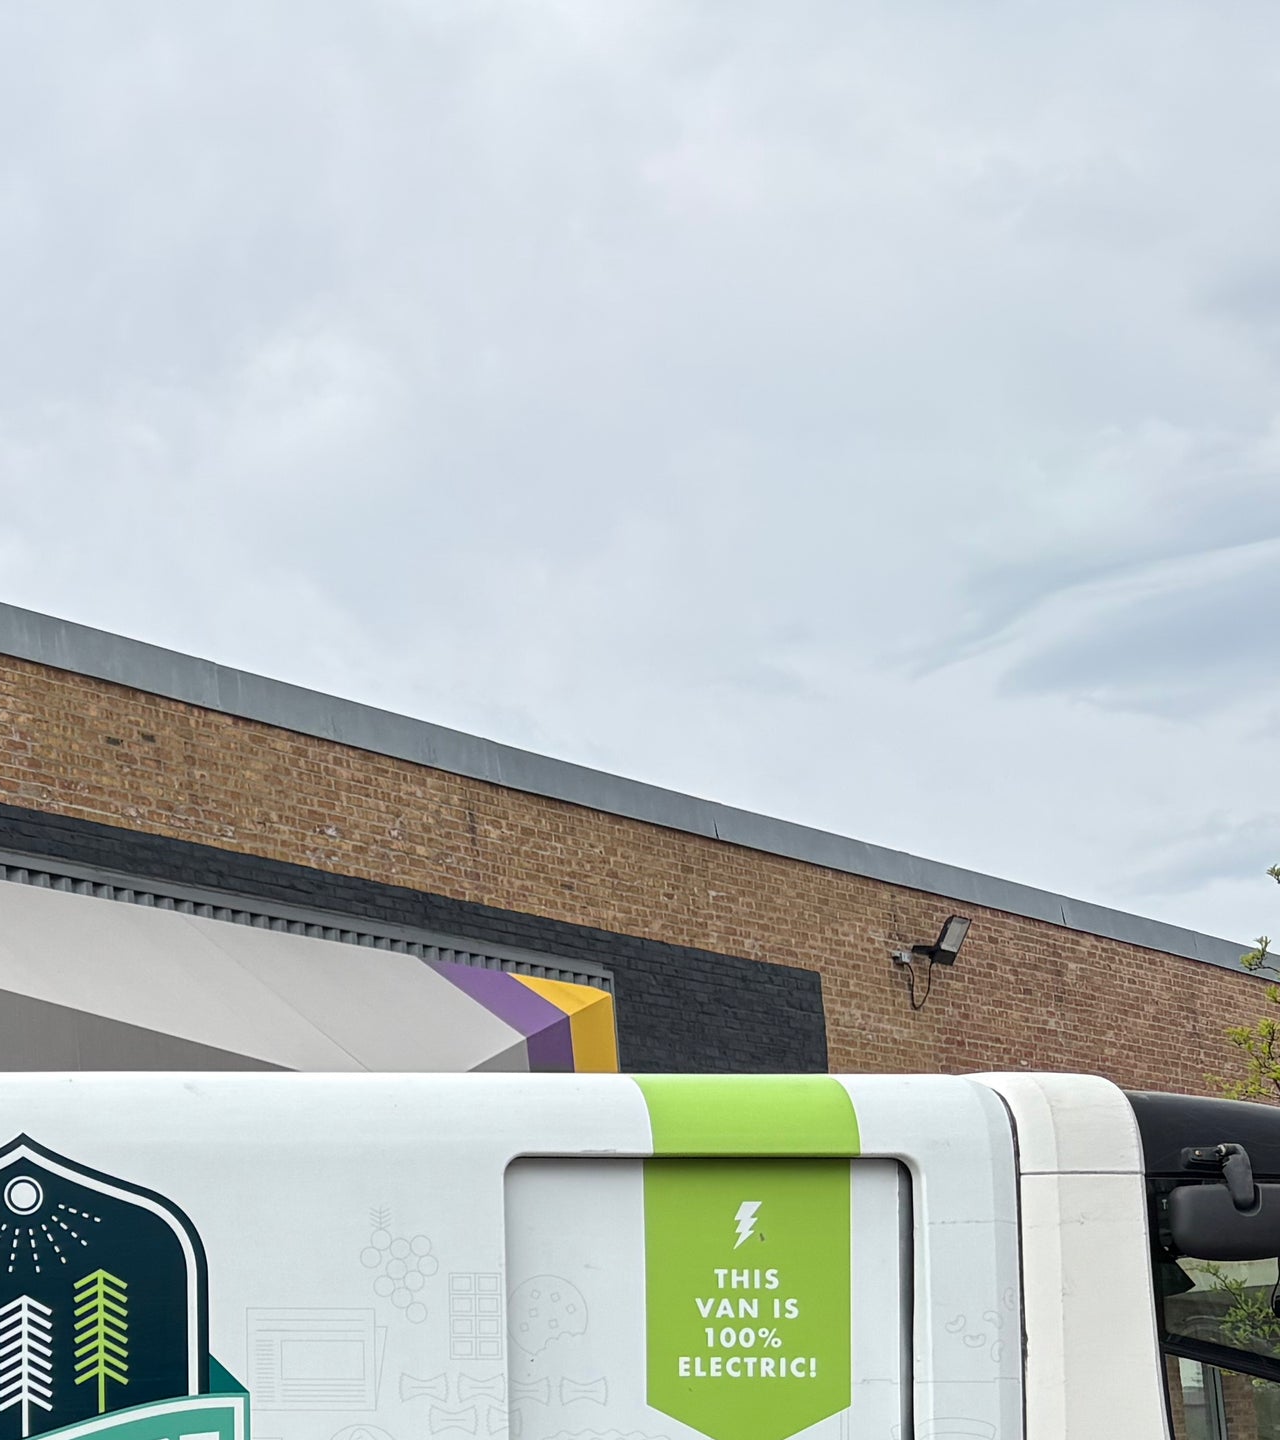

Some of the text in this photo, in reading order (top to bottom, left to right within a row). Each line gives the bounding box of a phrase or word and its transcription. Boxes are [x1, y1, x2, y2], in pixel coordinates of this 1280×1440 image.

[715, 1269, 779, 1289] THIS
[696, 1298, 799, 1319] VAN IS
[705, 1327, 782, 1348] 100%
[679, 1357, 816, 1377] ELECTRIC!
